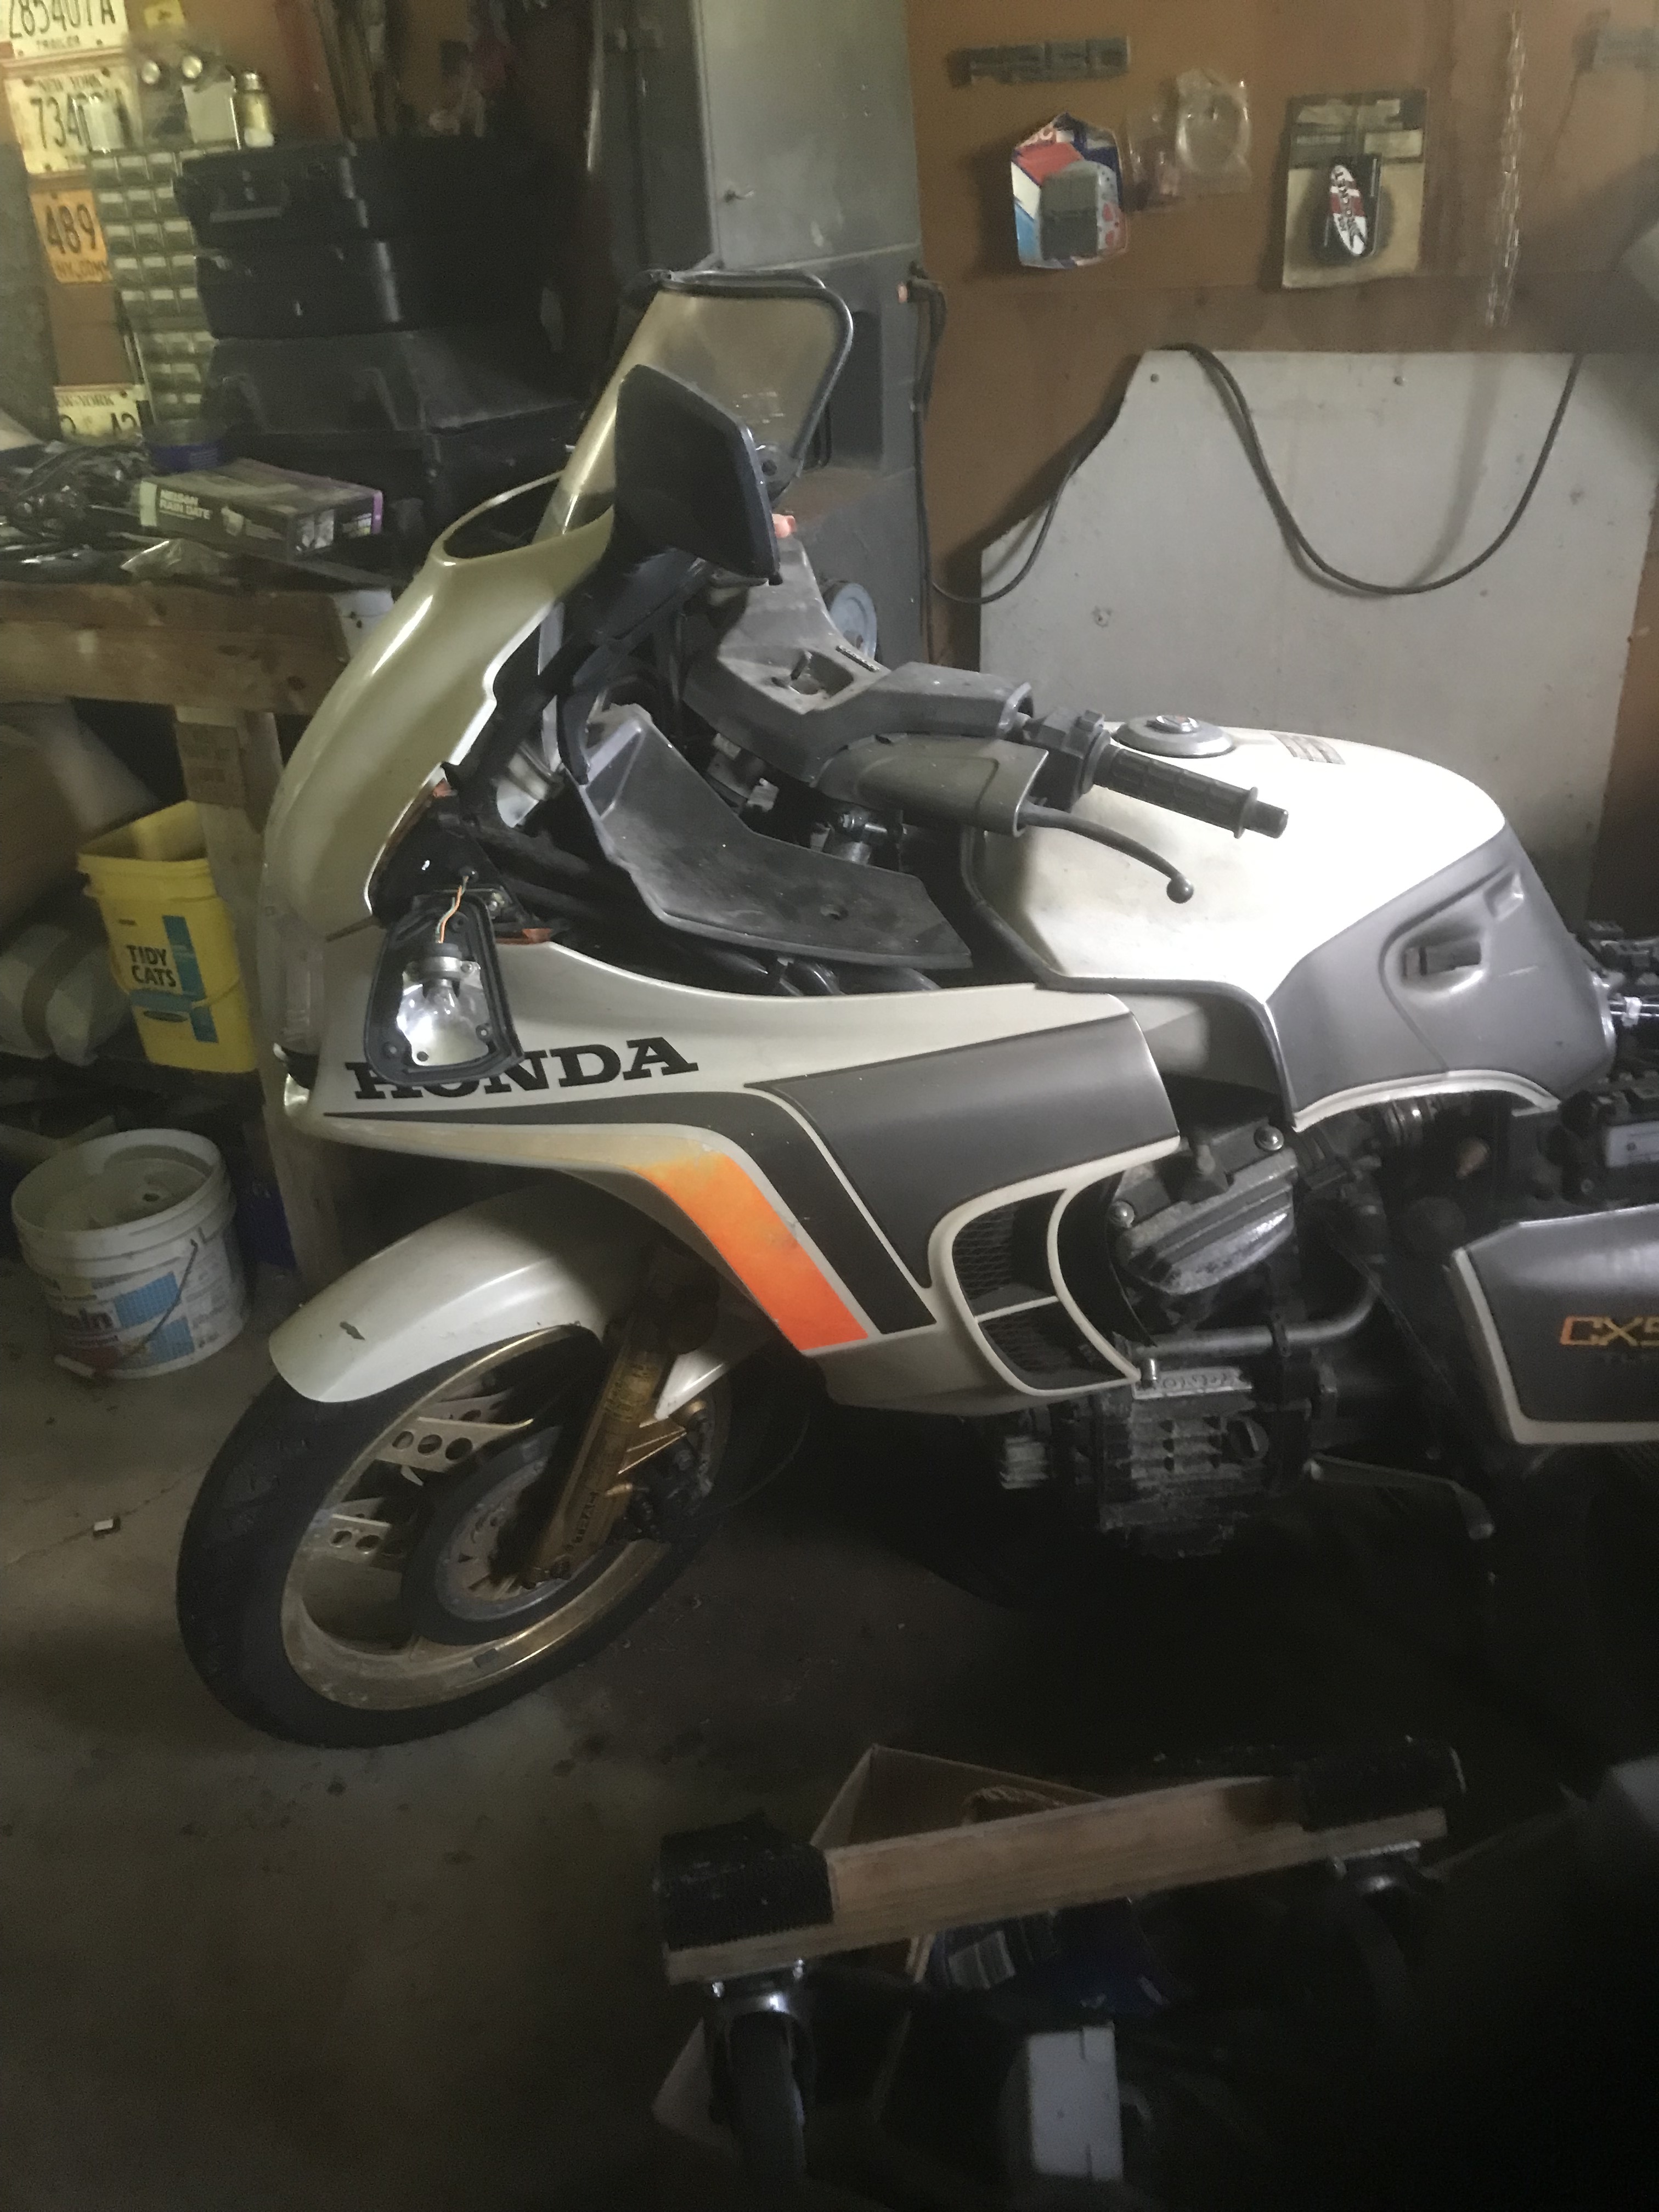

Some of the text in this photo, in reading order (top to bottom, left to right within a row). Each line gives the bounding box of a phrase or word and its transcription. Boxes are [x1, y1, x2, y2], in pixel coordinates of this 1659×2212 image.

[46, 203, 96, 255] 489
[126, 944, 167, 966] TIDY
[132, 964, 177, 988] CATS
[345, 1036, 698, 1099] HNDA
